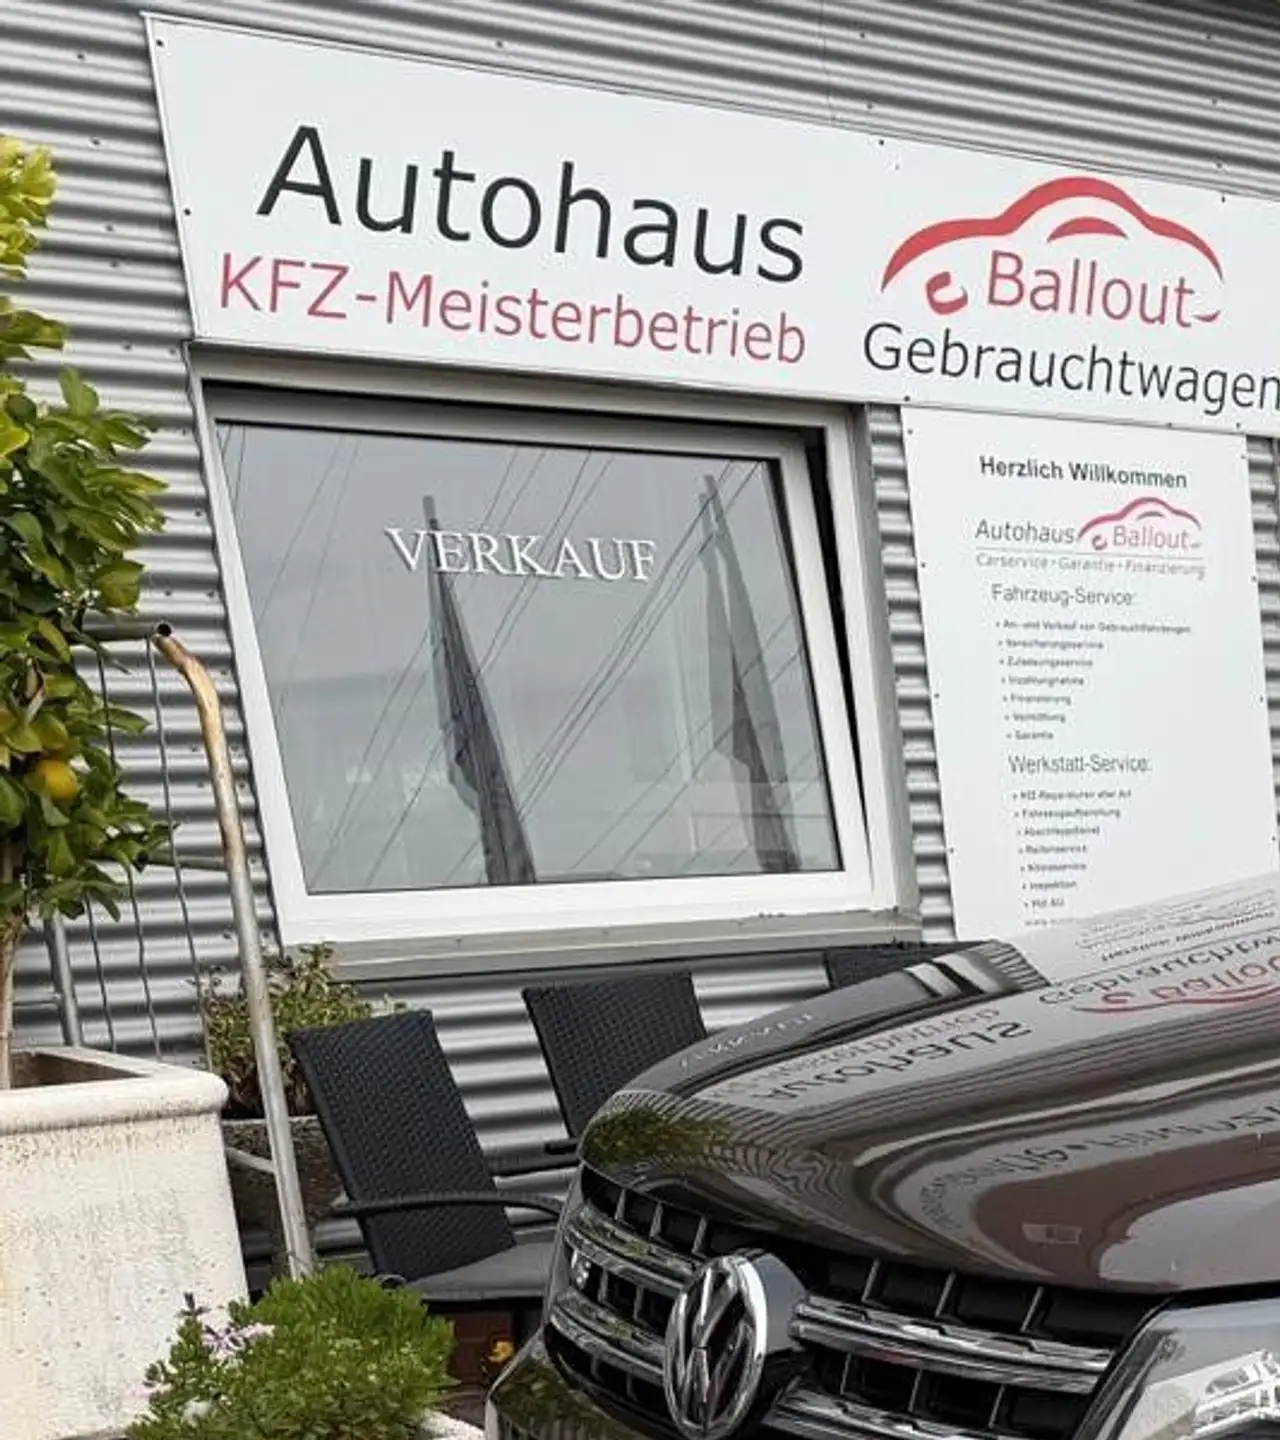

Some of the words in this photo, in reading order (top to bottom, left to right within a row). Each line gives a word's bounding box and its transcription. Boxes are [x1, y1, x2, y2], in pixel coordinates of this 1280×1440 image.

[256, 124, 805, 284] Autohaus
[218, 251, 807, 365] KFZ-Meisterbetrieb
[987, 250, 1196, 329] Ballout
[979, 455, 1064, 481] Herzlich
[1069, 462, 1188, 488] Willkommen
[384, 526, 656, 582] VERKAUF
[975, 519, 1076, 545] Autohaus
[1112, 525, 1190, 550] Ballout
